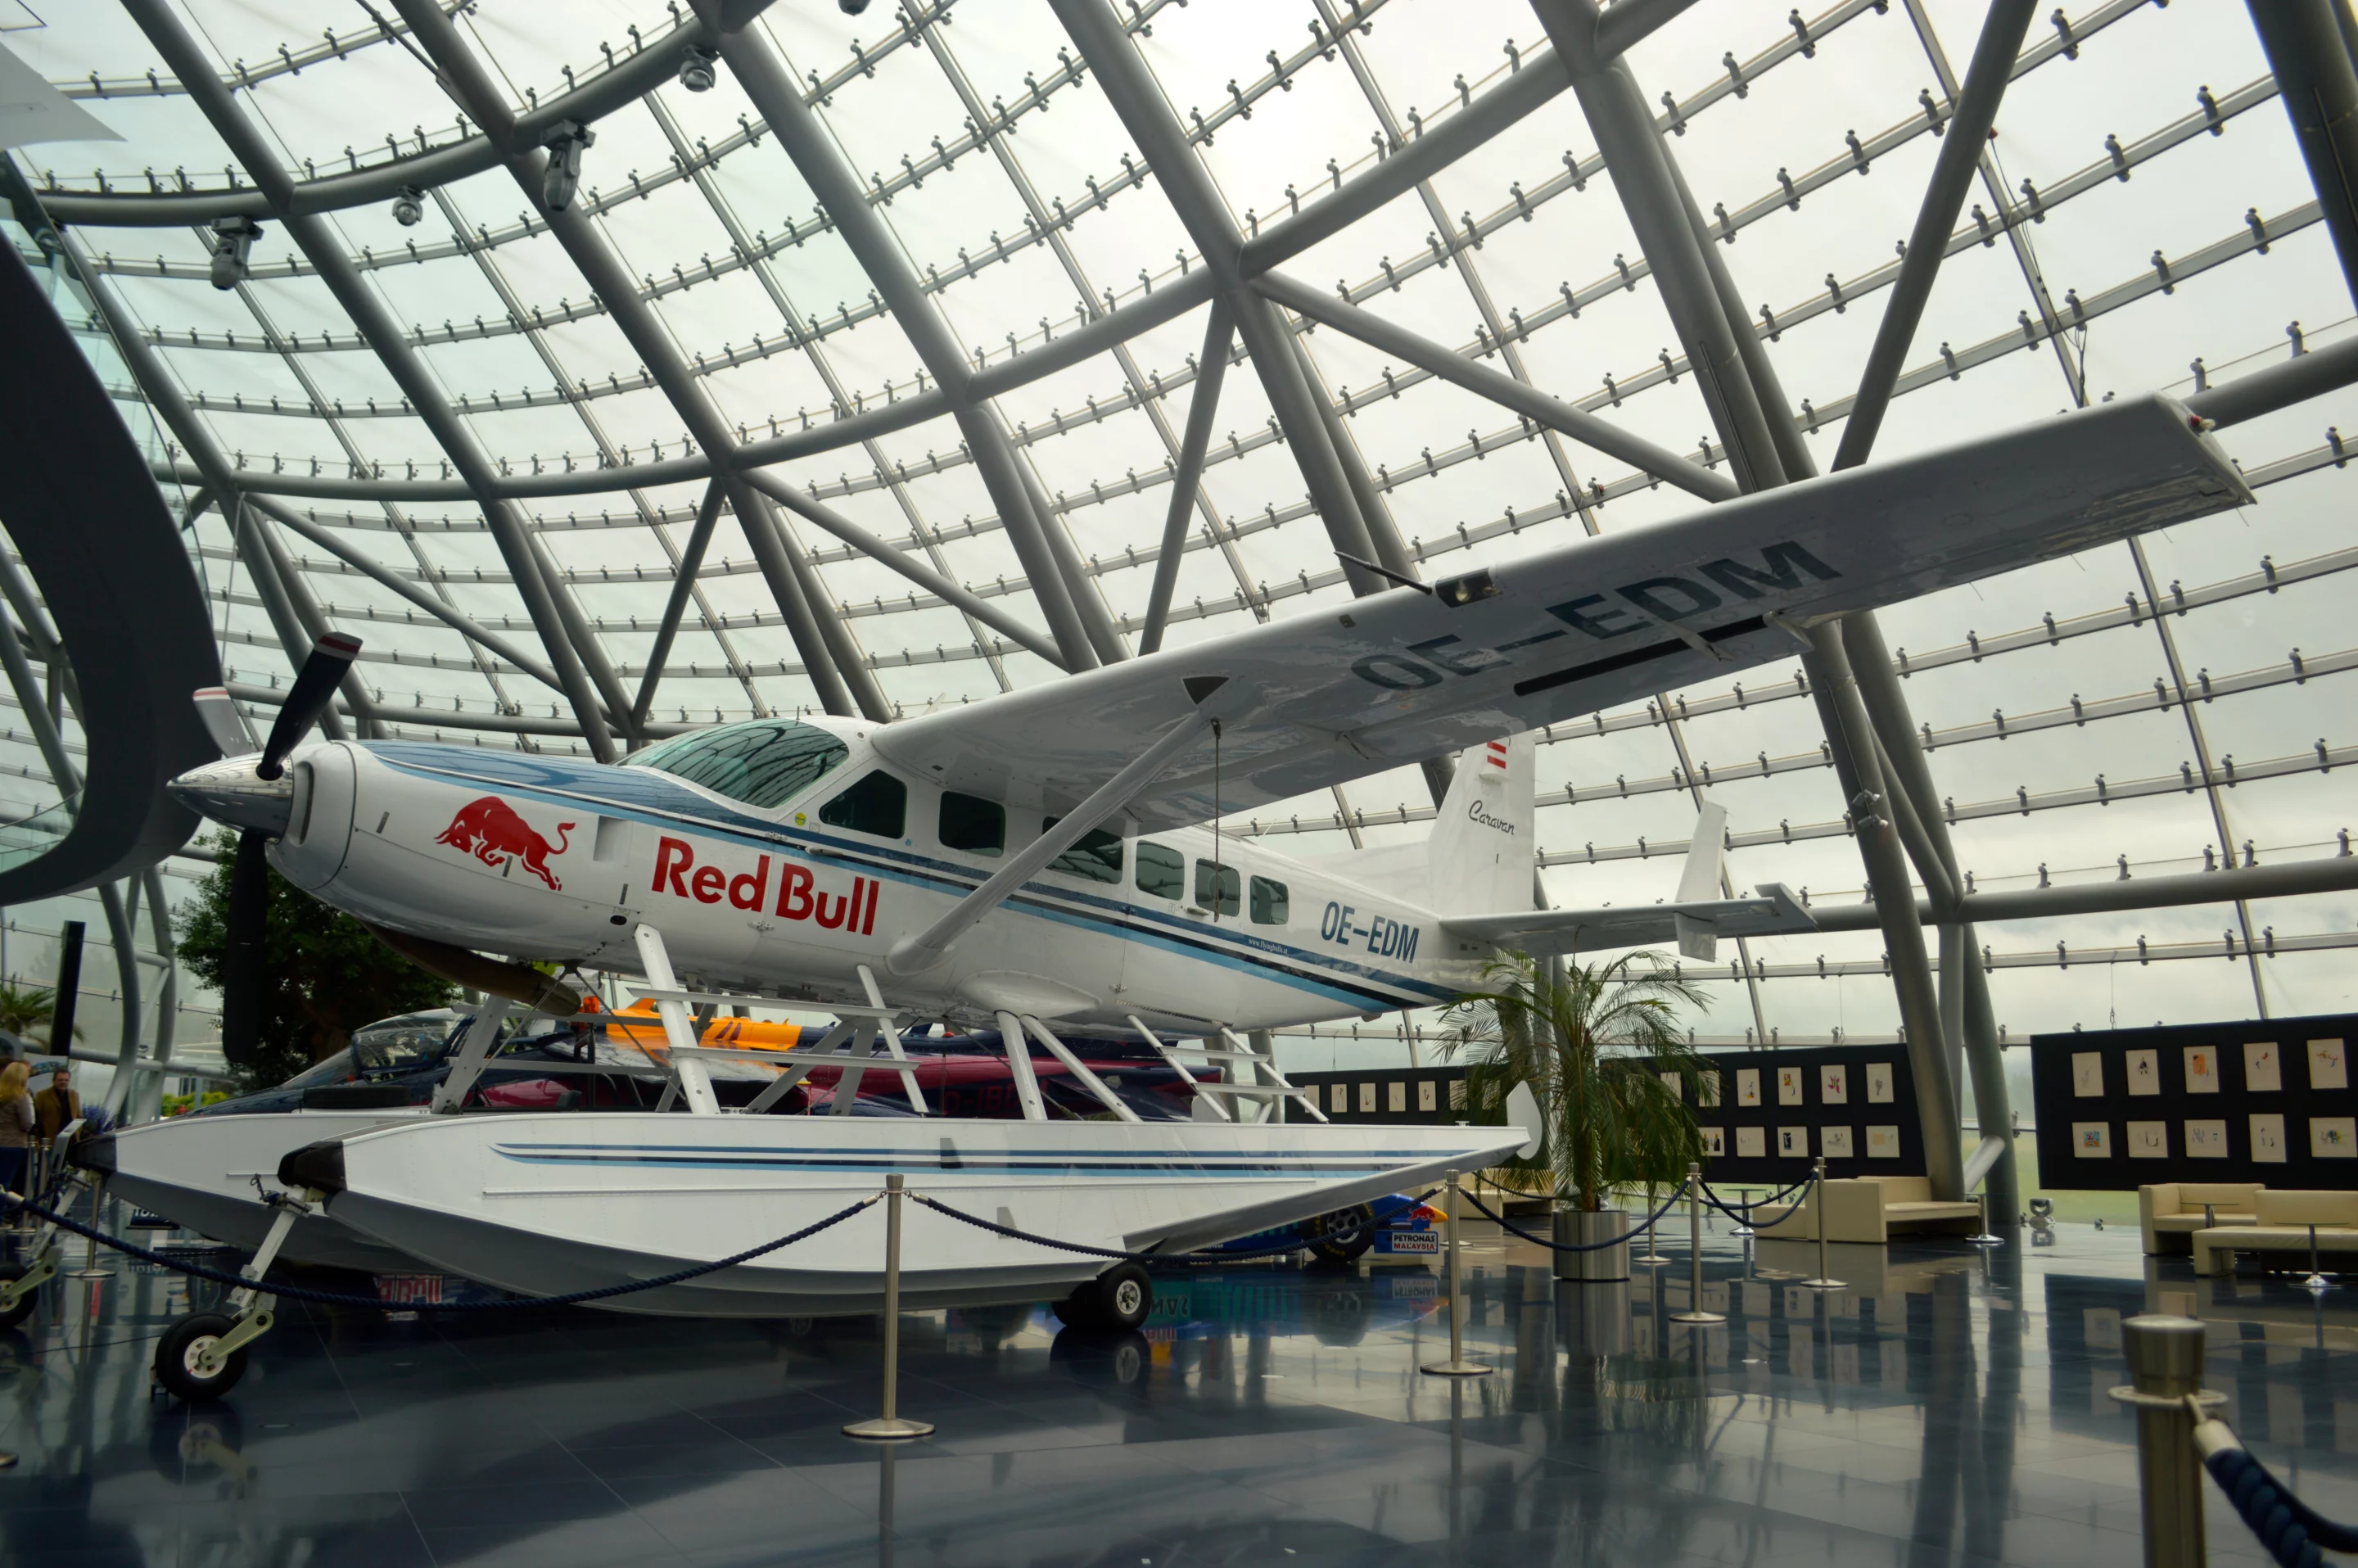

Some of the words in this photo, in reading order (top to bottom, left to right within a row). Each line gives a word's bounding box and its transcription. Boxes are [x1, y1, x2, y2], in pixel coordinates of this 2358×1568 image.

[1351, 540, 1843, 691] OE-EDM
[1469, 800, 1515, 835] Caravan
[652, 836, 770, 912] Red
[775, 862, 879, 936] Bull
[1321, 901, 1420, 964] OE-EDM
[1394, 1234, 1435, 1243] PETRONAS
[1394, 1243, 1435, 1251] MALAYSIA
